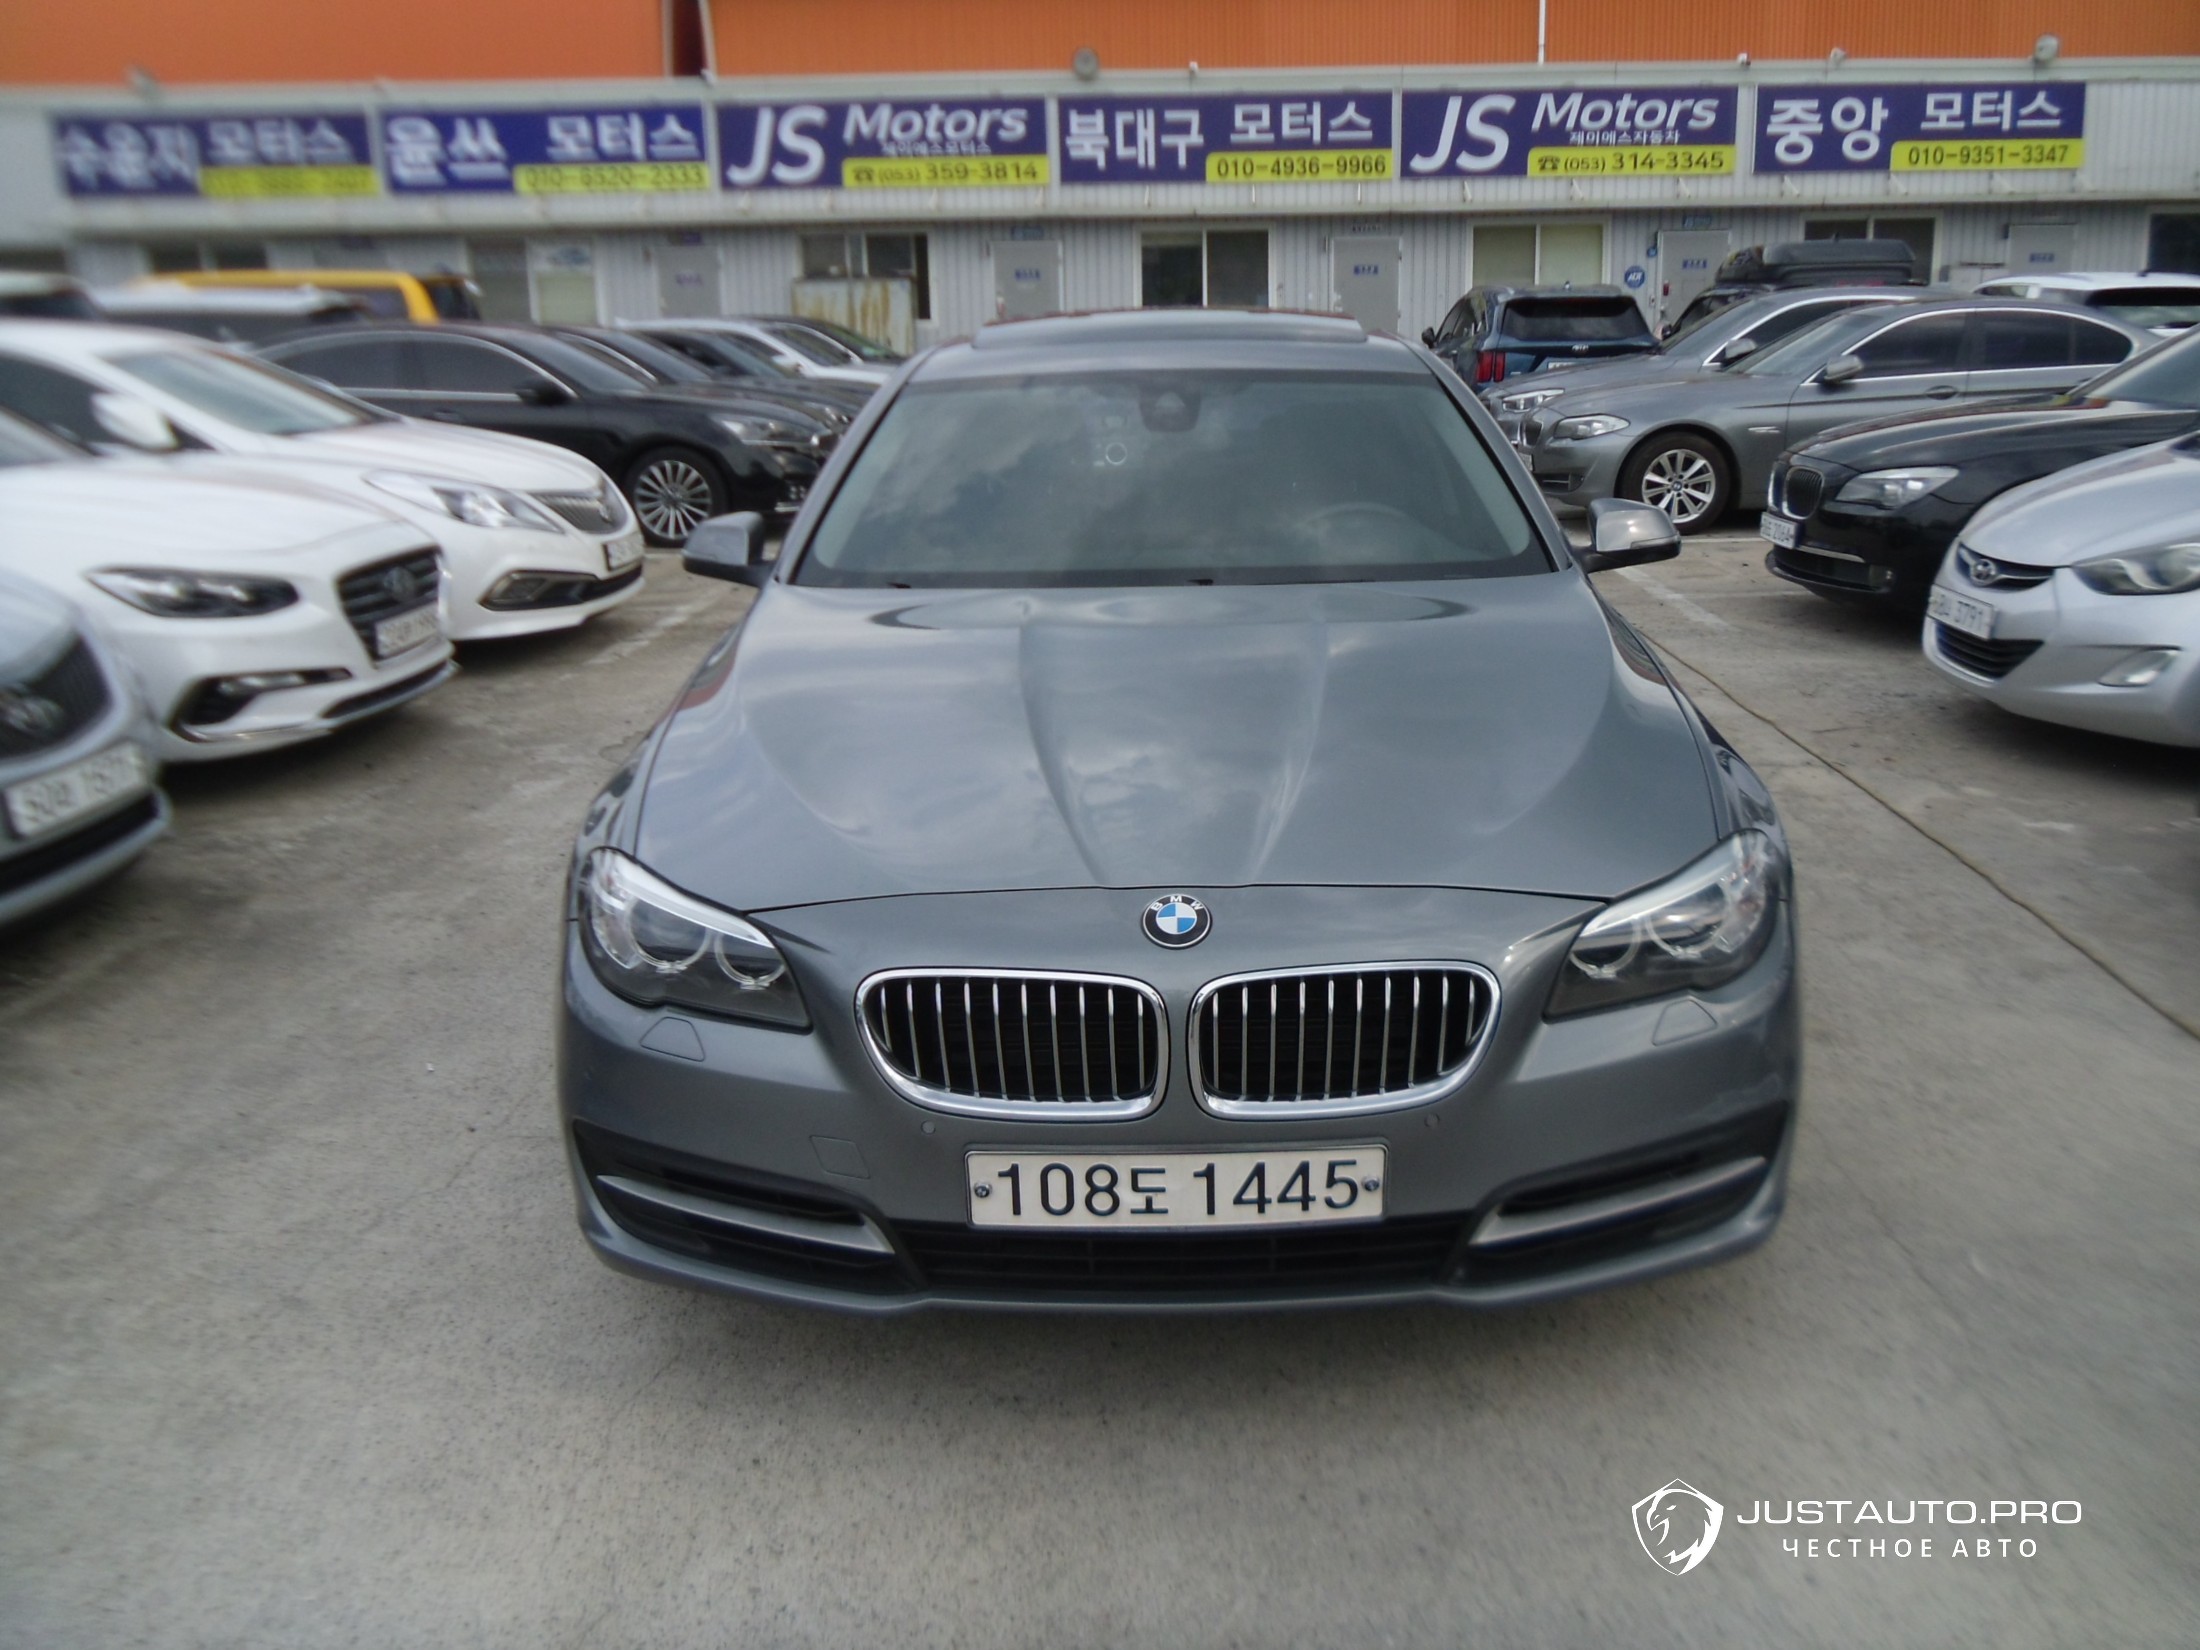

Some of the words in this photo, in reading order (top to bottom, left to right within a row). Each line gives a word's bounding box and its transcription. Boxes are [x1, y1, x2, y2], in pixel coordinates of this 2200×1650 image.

[546, 111, 701, 162] 모터스
[726, 105, 828, 184] JS
[842, 102, 1028, 143] Motors
[1066, 107, 1205, 170] 북대구
[1230, 100, 1374, 145] 모터스
[1409, 95, 1517, 172] JS
[1530, 91, 1720, 133] Motors
[1766, 95, 1888, 165] 중앙
[1920, 90, 2062, 131] 모터스
[925, 161, 1038, 181] 359-3814
[1217, 155, 1387, 178] 010-4936-9966
[1563, 156, 1606, 173] (053)
[1611, 151, 1725, 171] 314-3345
[1908, 143, 2069, 166] 010-9351-3347
[1150, 894, 1204, 912] BMW
[997, 1161, 1169, 1216] 108도
[1193, 1158, 1360, 1216] 1445
